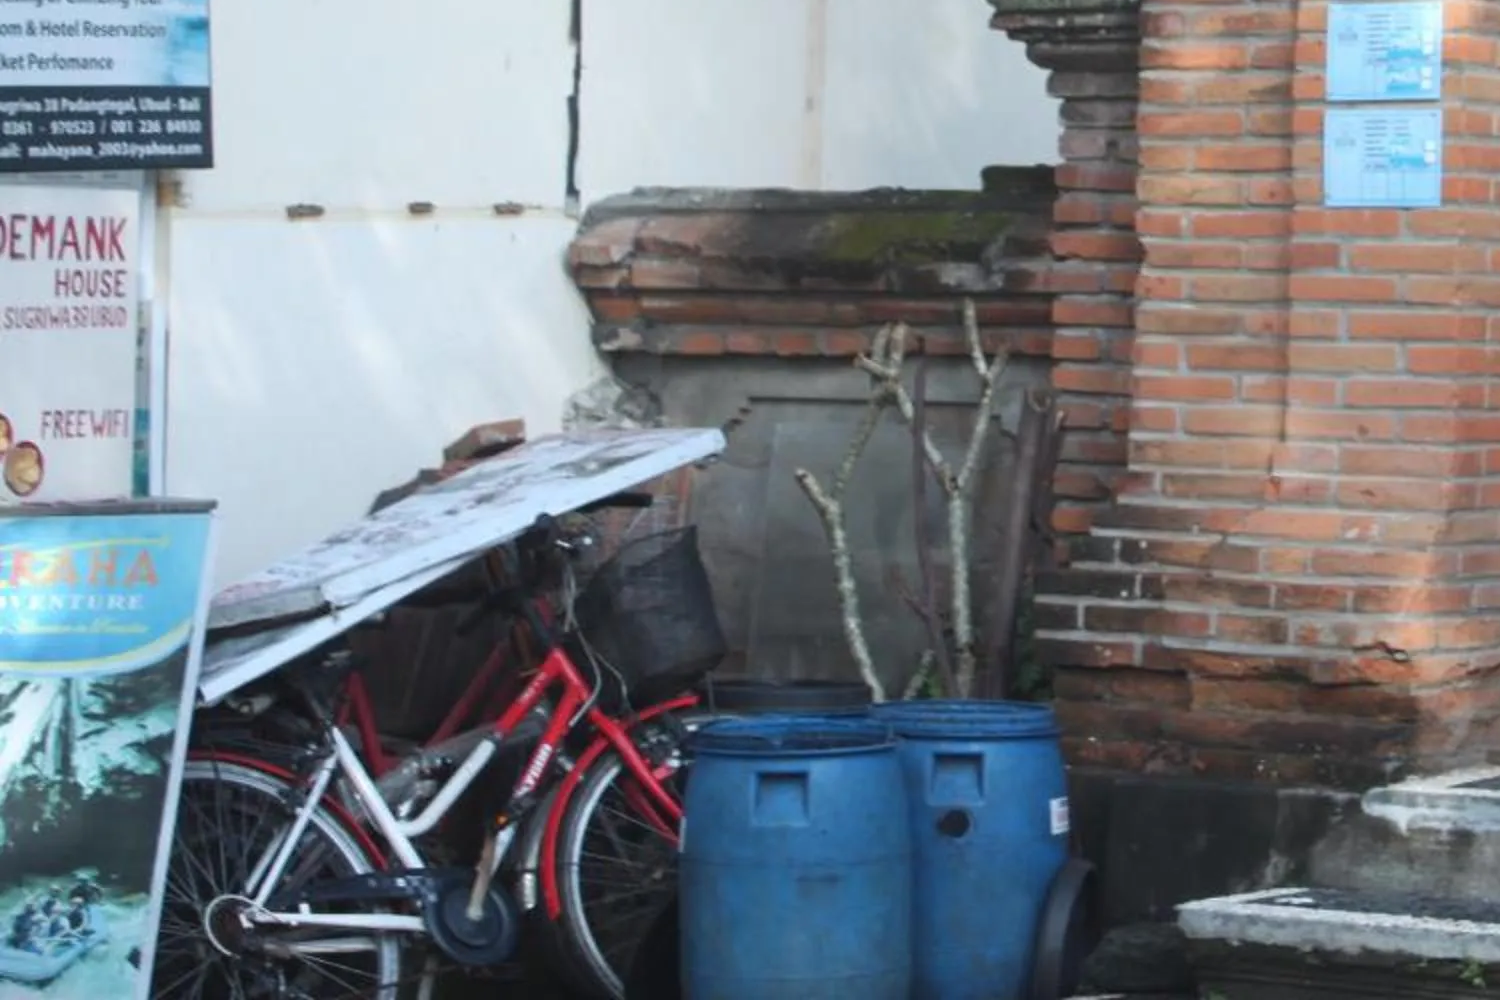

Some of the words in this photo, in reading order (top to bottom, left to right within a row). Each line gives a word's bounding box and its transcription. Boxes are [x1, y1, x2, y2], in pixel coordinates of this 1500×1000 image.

[40, 21, 80, 37] Hotel
[83, 21, 167, 38] Reservation
[54, 268, 128, 298] HOUSE
